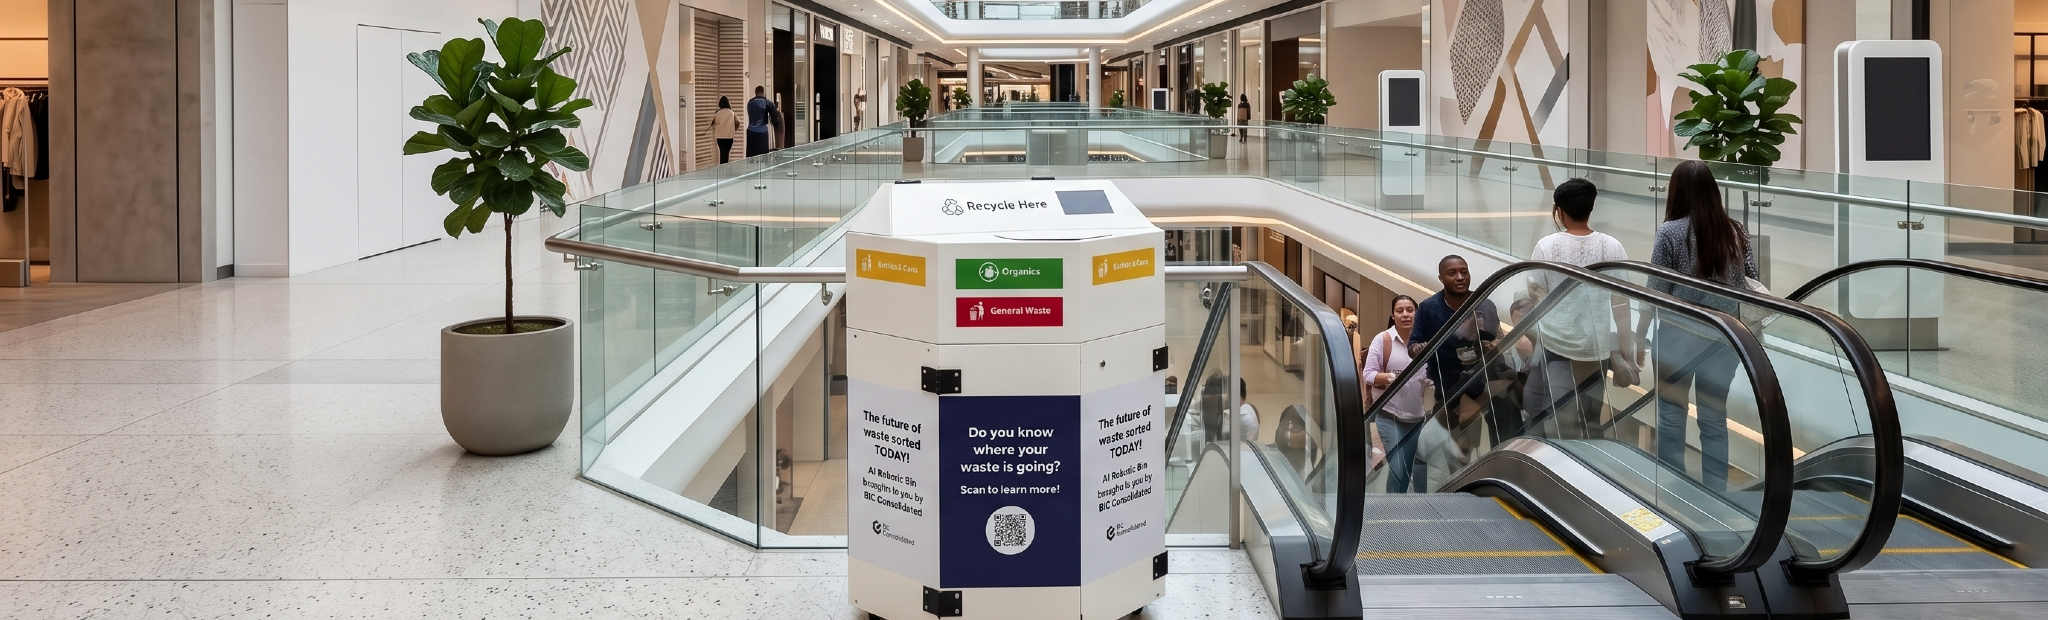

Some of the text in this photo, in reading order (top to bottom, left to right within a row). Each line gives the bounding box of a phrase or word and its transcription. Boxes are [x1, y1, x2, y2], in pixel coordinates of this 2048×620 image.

[967, 200, 1047, 212] Recycle Here
[1001, 267, 1041, 278] Organics
[990, 306, 1052, 315] General Waste
[863, 410, 922, 434] The future of
[1098, 404, 1151, 430] The future of
[863, 428, 921, 451] waste sorted
[968, 426, 1054, 440] Do you know
[1099, 421, 1151, 446] waste sorted
[874, 444, 910, 464] TODAY!
[973, 444, 1048, 457] where your
[1110, 439, 1142, 459] TODAY!
[960, 460, 1060, 475] waste is going?
[960, 485, 1060, 494] Scan to learn more!
[1131, 477, 1144, 489] you
[864, 491, 876, 502] BIC
[900, 490, 914, 499] you
[914, 492, 924, 505] by
[1098, 500, 1111, 512] BIC
